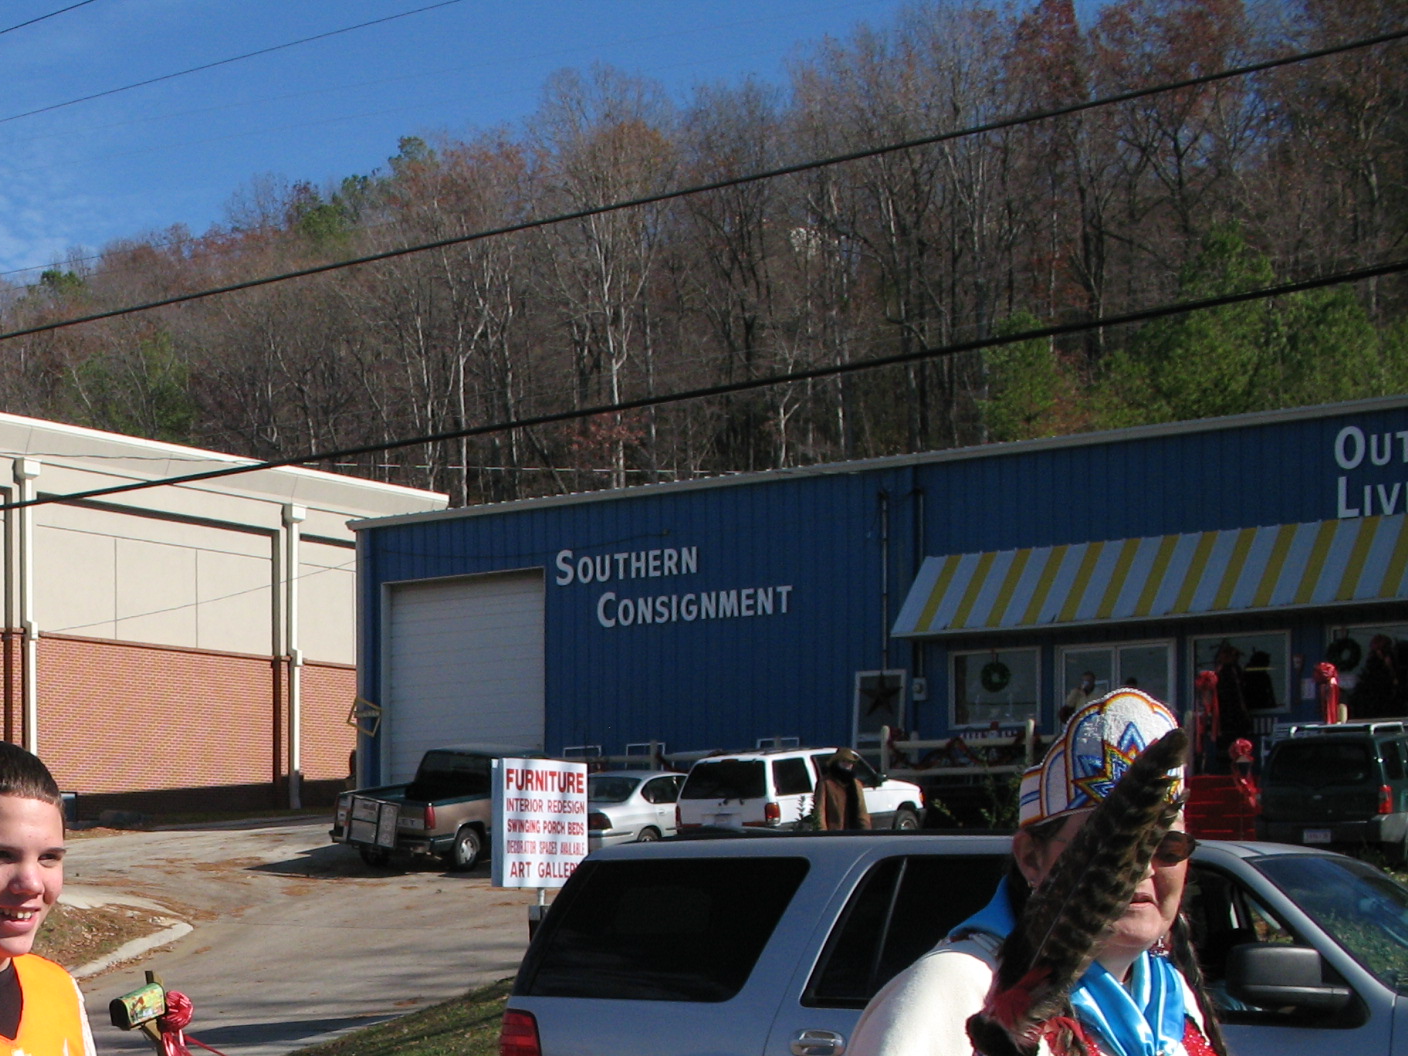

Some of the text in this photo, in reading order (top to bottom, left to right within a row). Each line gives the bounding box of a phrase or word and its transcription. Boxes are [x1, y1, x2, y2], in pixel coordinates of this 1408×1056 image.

[556, 546, 698, 586] SOUTHERN
[596, 585, 792, 628] CONSIGNMENT
[506, 768, 585, 794] FURNITURE
[506, 798, 585, 814] INTERIOR REDESIGN
[507, 819, 585, 836] SWINGING PORCH BEDS
[560, 842, 585, 856] AVAILABLE
[510, 862, 580, 878] ART GALLER
